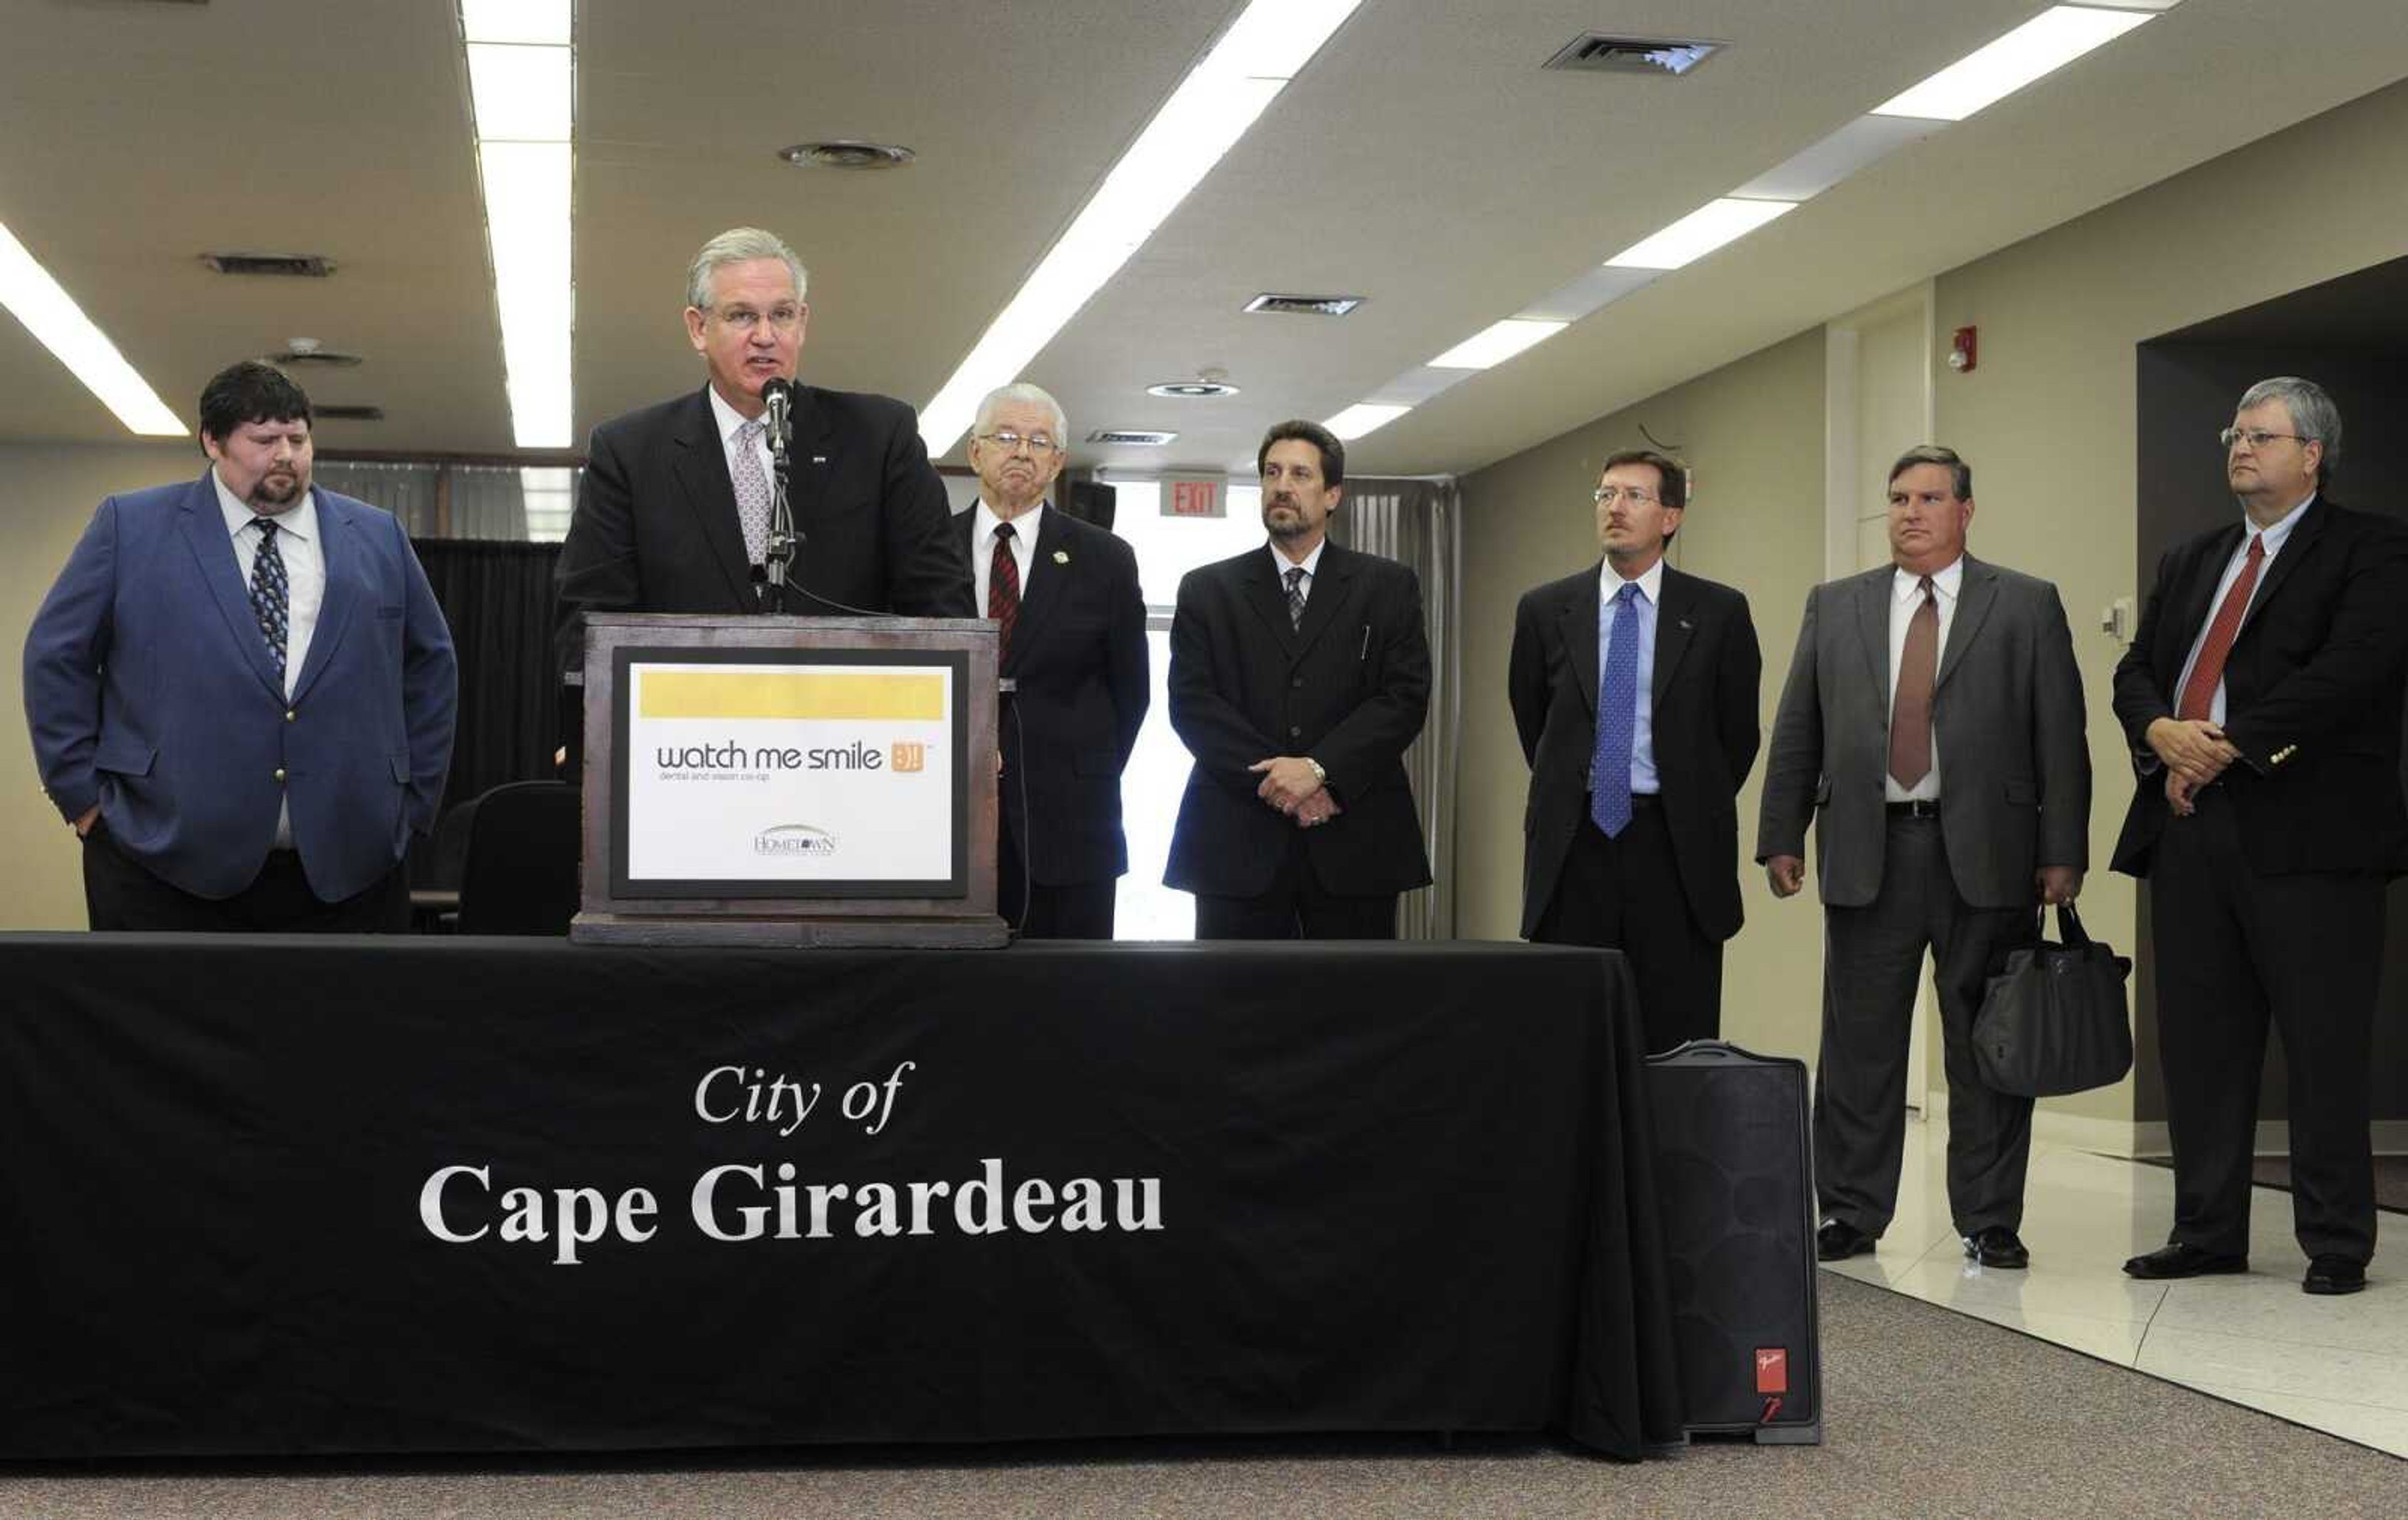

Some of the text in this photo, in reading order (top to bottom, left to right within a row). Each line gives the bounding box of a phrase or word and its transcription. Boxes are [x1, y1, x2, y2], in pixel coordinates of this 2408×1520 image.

[1174, 482, 1218, 512] EXIT
[657, 739, 747, 769] watch
[756, 747, 802, 769] me
[808, 740, 882, 770] smile
[695, 1061, 916, 1136] City of
[420, 1158, 1164, 1264] Cape Girardeau
